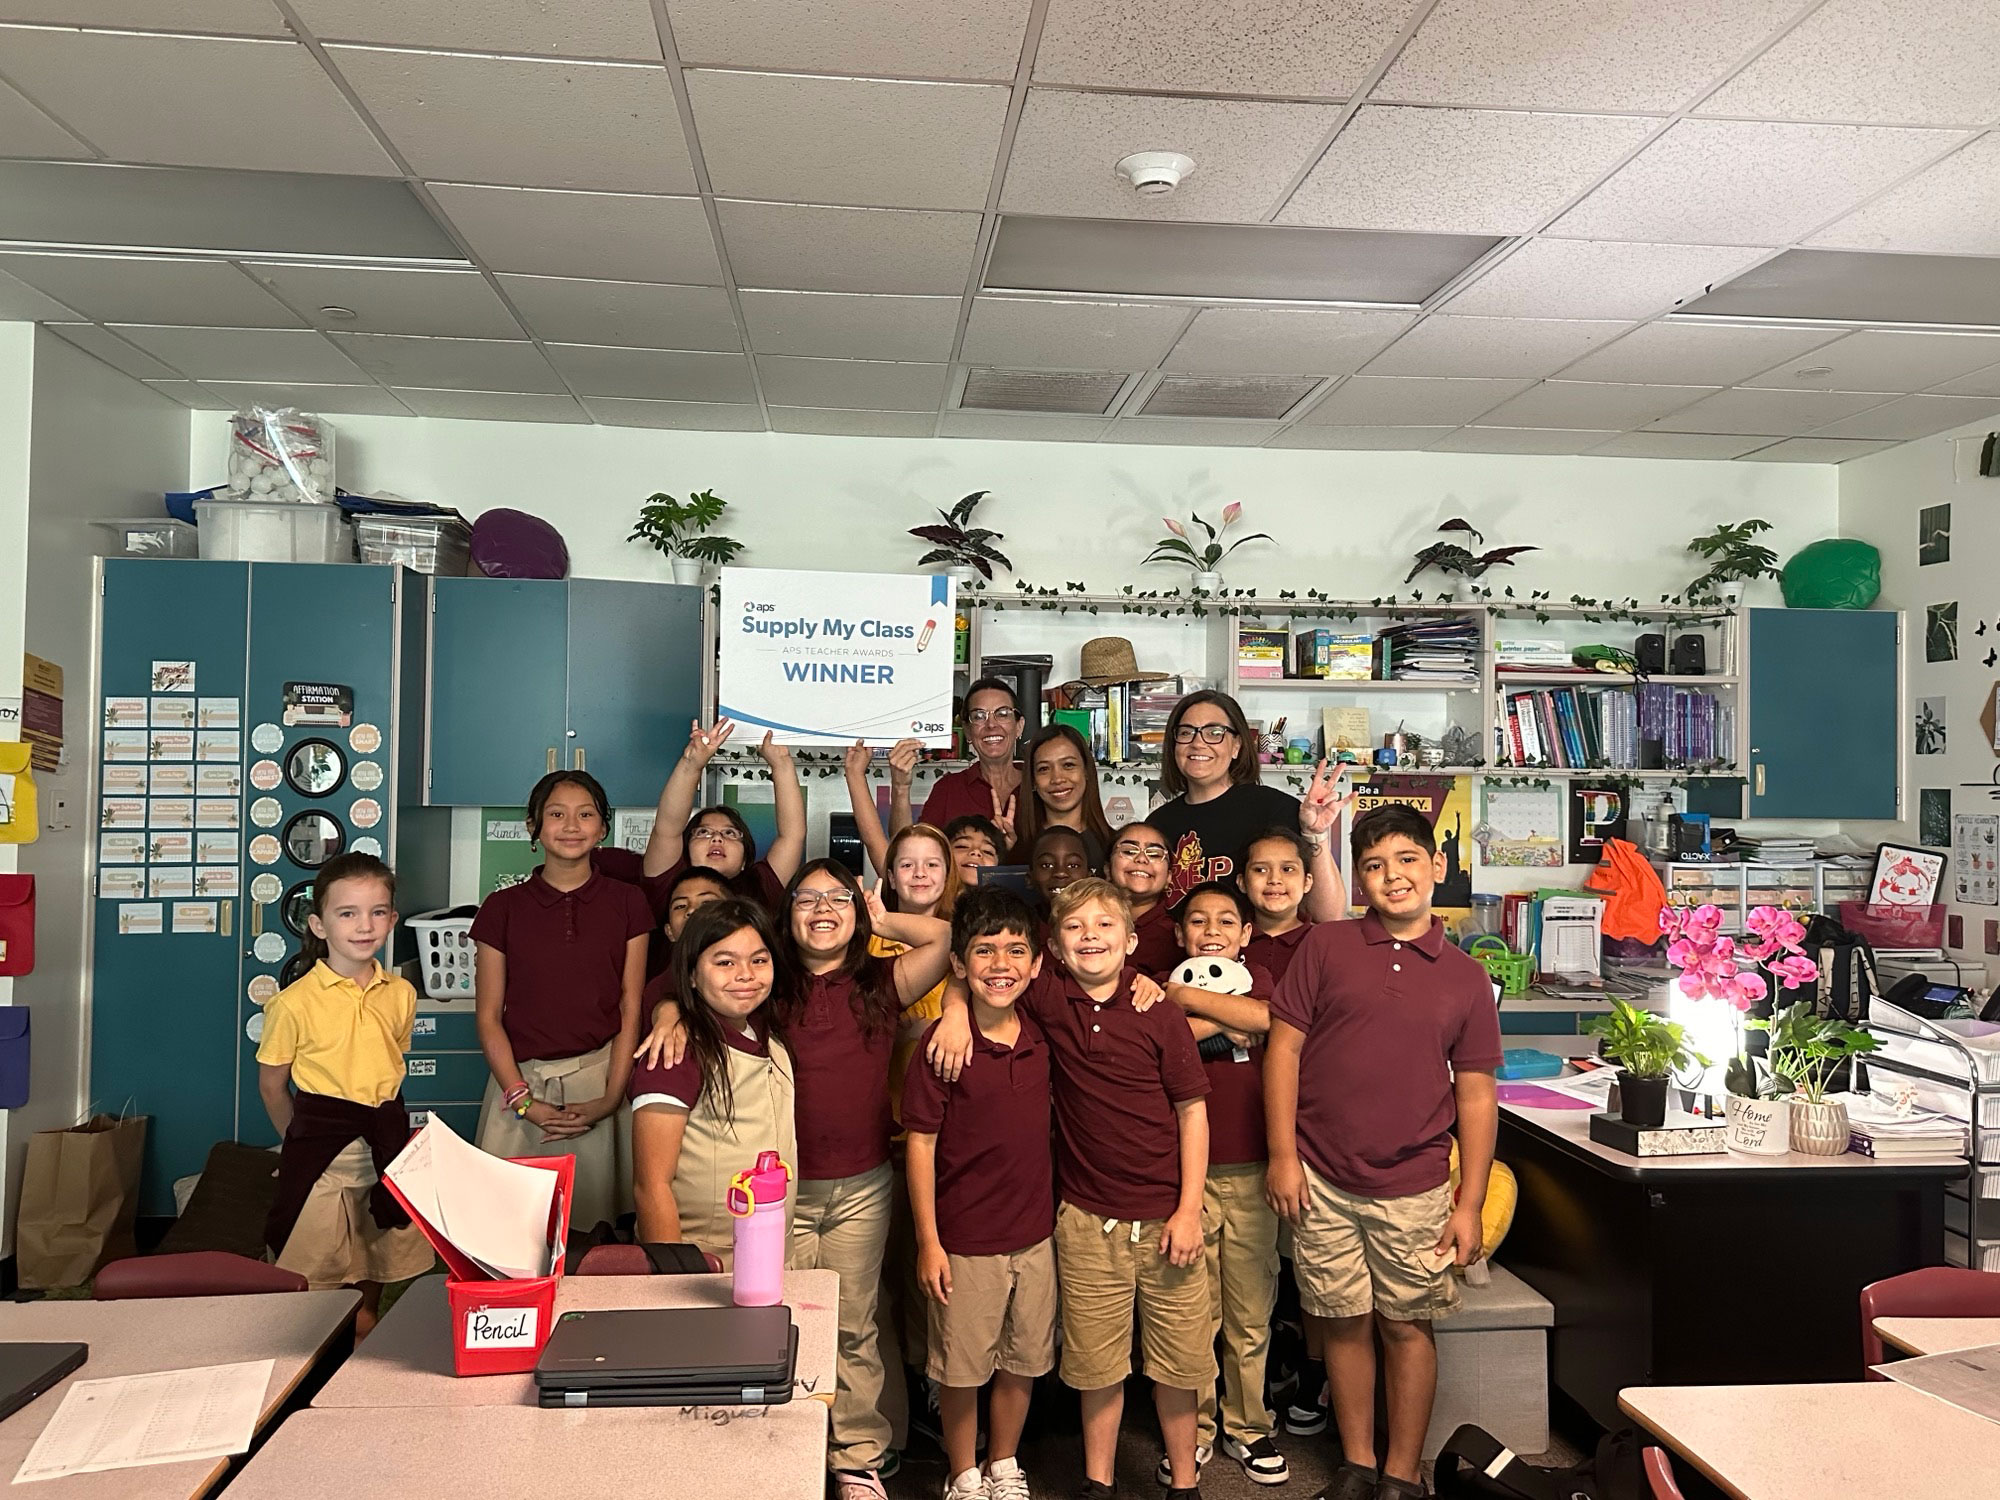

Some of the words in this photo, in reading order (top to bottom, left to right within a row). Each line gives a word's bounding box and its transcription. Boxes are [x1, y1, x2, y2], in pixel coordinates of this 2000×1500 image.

[756, 602, 775, 613] aps
[742, 615, 818, 639] Supply
[823, 618, 856, 640] My
[861, 620, 914, 639] Class
[782, 646, 801, 655] APS
[805, 648, 850, 656] TEACHER
[853, 649, 894, 657] AWARDS
[783, 662, 894, 684] WINNER
[293, 685, 340, 696] AFFIRMATION
[301, 695, 334, 703] STATION
[924, 722, 945, 733] aps
[1358, 786, 1371, 794] Be
[624, 817, 641, 833] Am
[643, 819, 651, 832] I
[1576, 790, 1621, 846] P
[487, 822, 522, 839] Lunch
[1731, 1100, 1773, 1122] Home
[1735, 1128, 1767, 1147] Lord
[678, 1405, 771, 1426] Miguel
